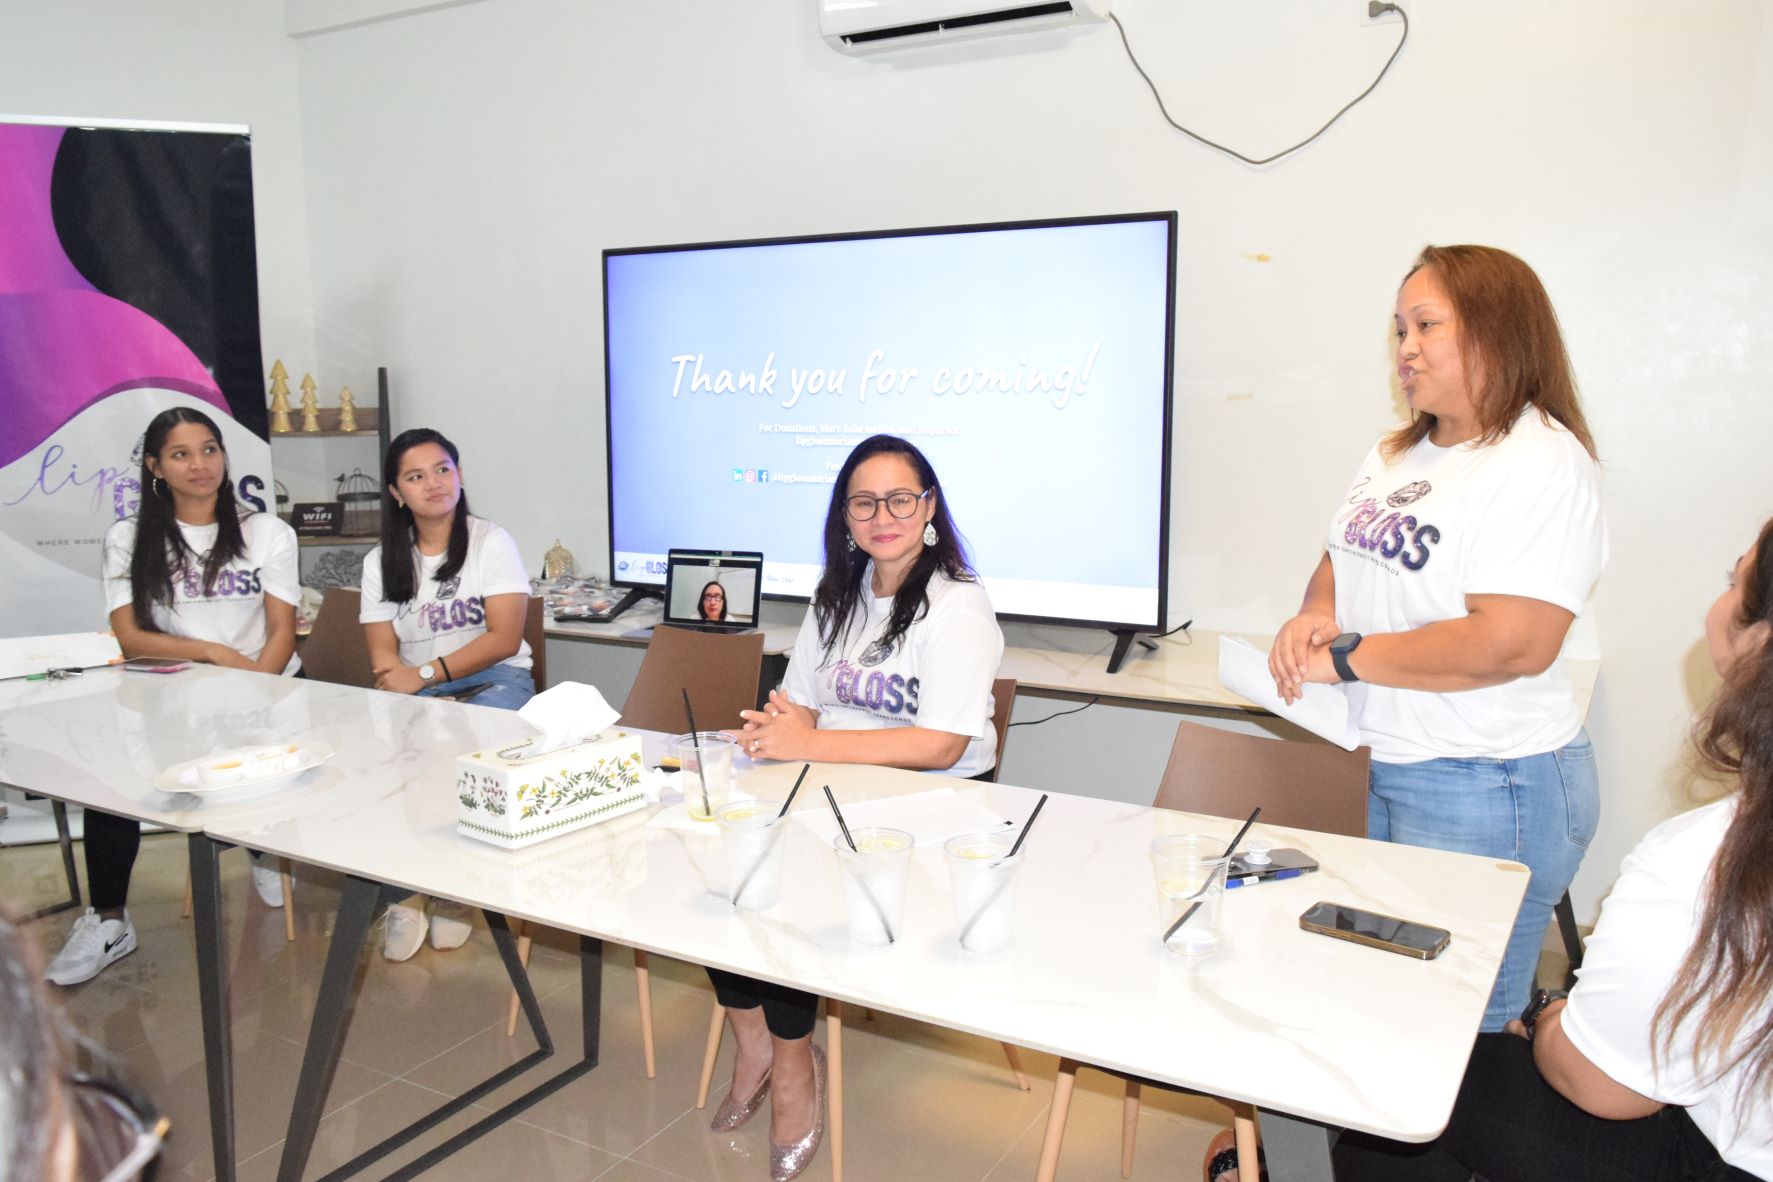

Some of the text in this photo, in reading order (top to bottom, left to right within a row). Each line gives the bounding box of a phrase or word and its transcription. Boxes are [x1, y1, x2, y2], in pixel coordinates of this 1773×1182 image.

[671, 339, 1102, 410] Thank you for coming!
[758, 423, 773, 433] For
[774, 423, 818, 434] Donations,
[3, 444, 130, 514] lip
[36, 539, 70, 547] WHERE
[1344, 503, 1441, 572] GLOSS
[428, 594, 486, 633] GLOS
